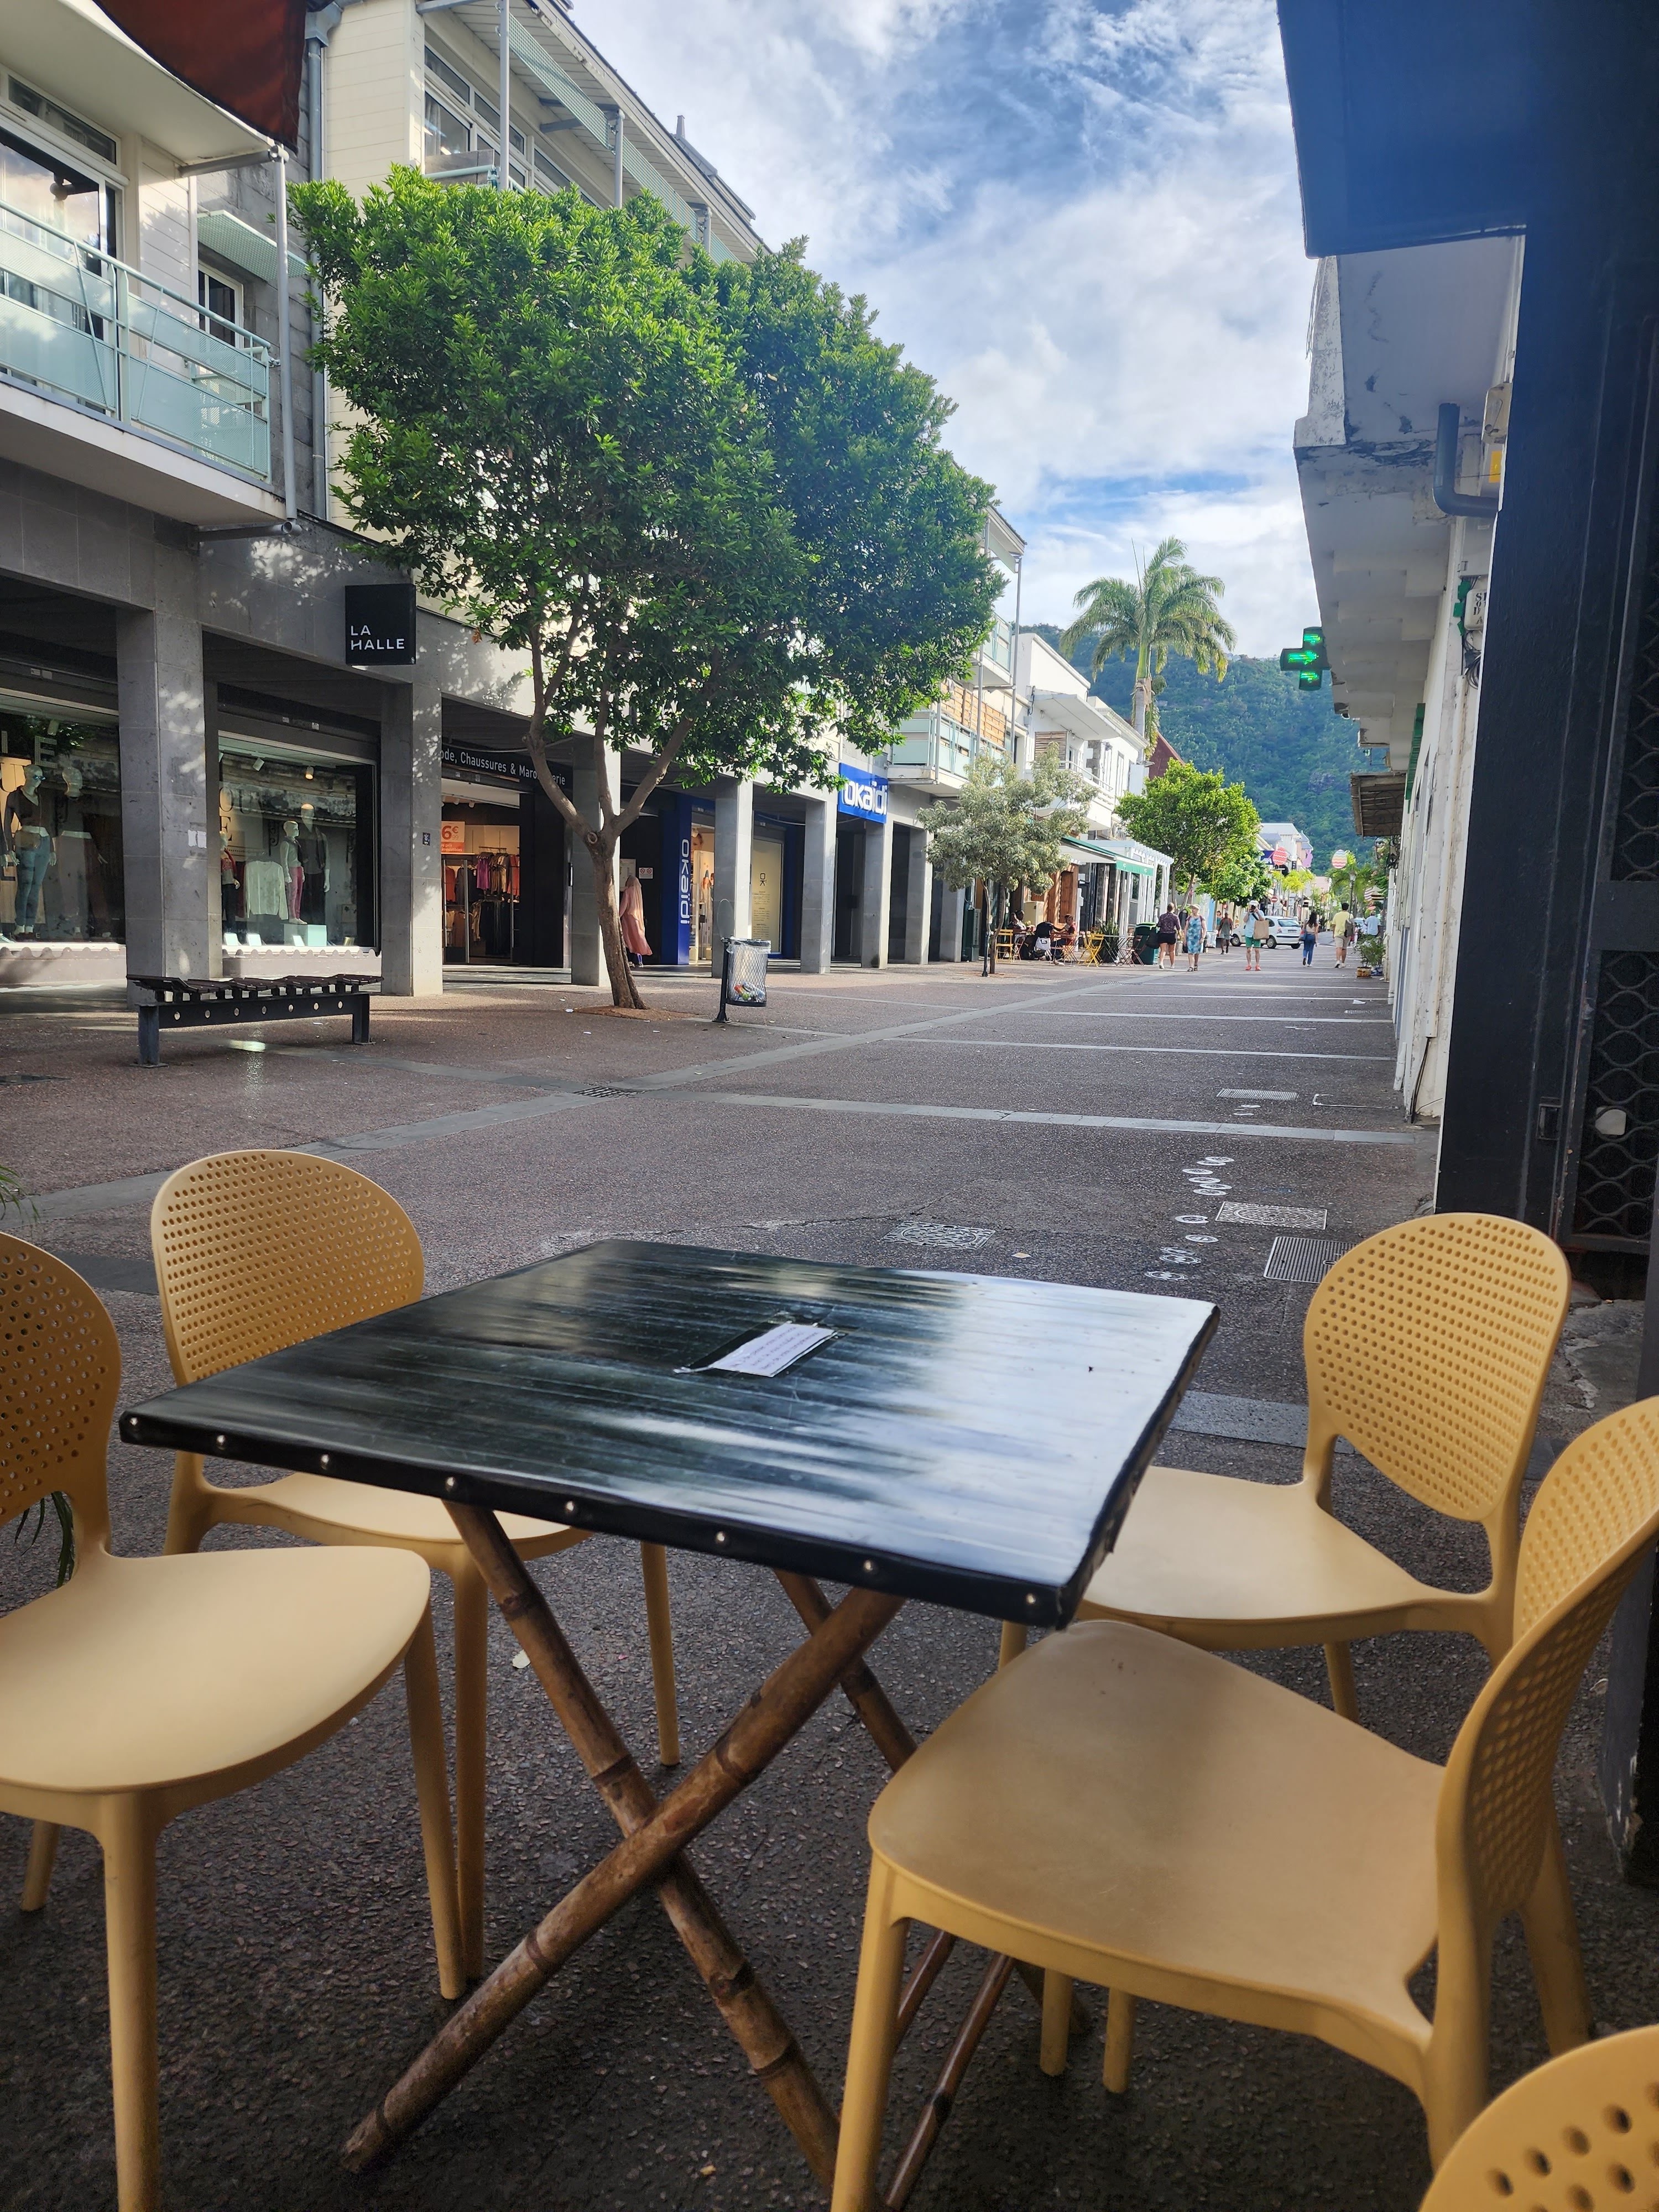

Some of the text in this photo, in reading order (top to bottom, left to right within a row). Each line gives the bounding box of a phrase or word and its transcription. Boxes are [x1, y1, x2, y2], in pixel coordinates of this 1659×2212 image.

[351, 625, 371, 635] LA
[351, 638, 405, 650] HALLE
[441, 748, 566, 786] ode, Chaussures & Maroerie
